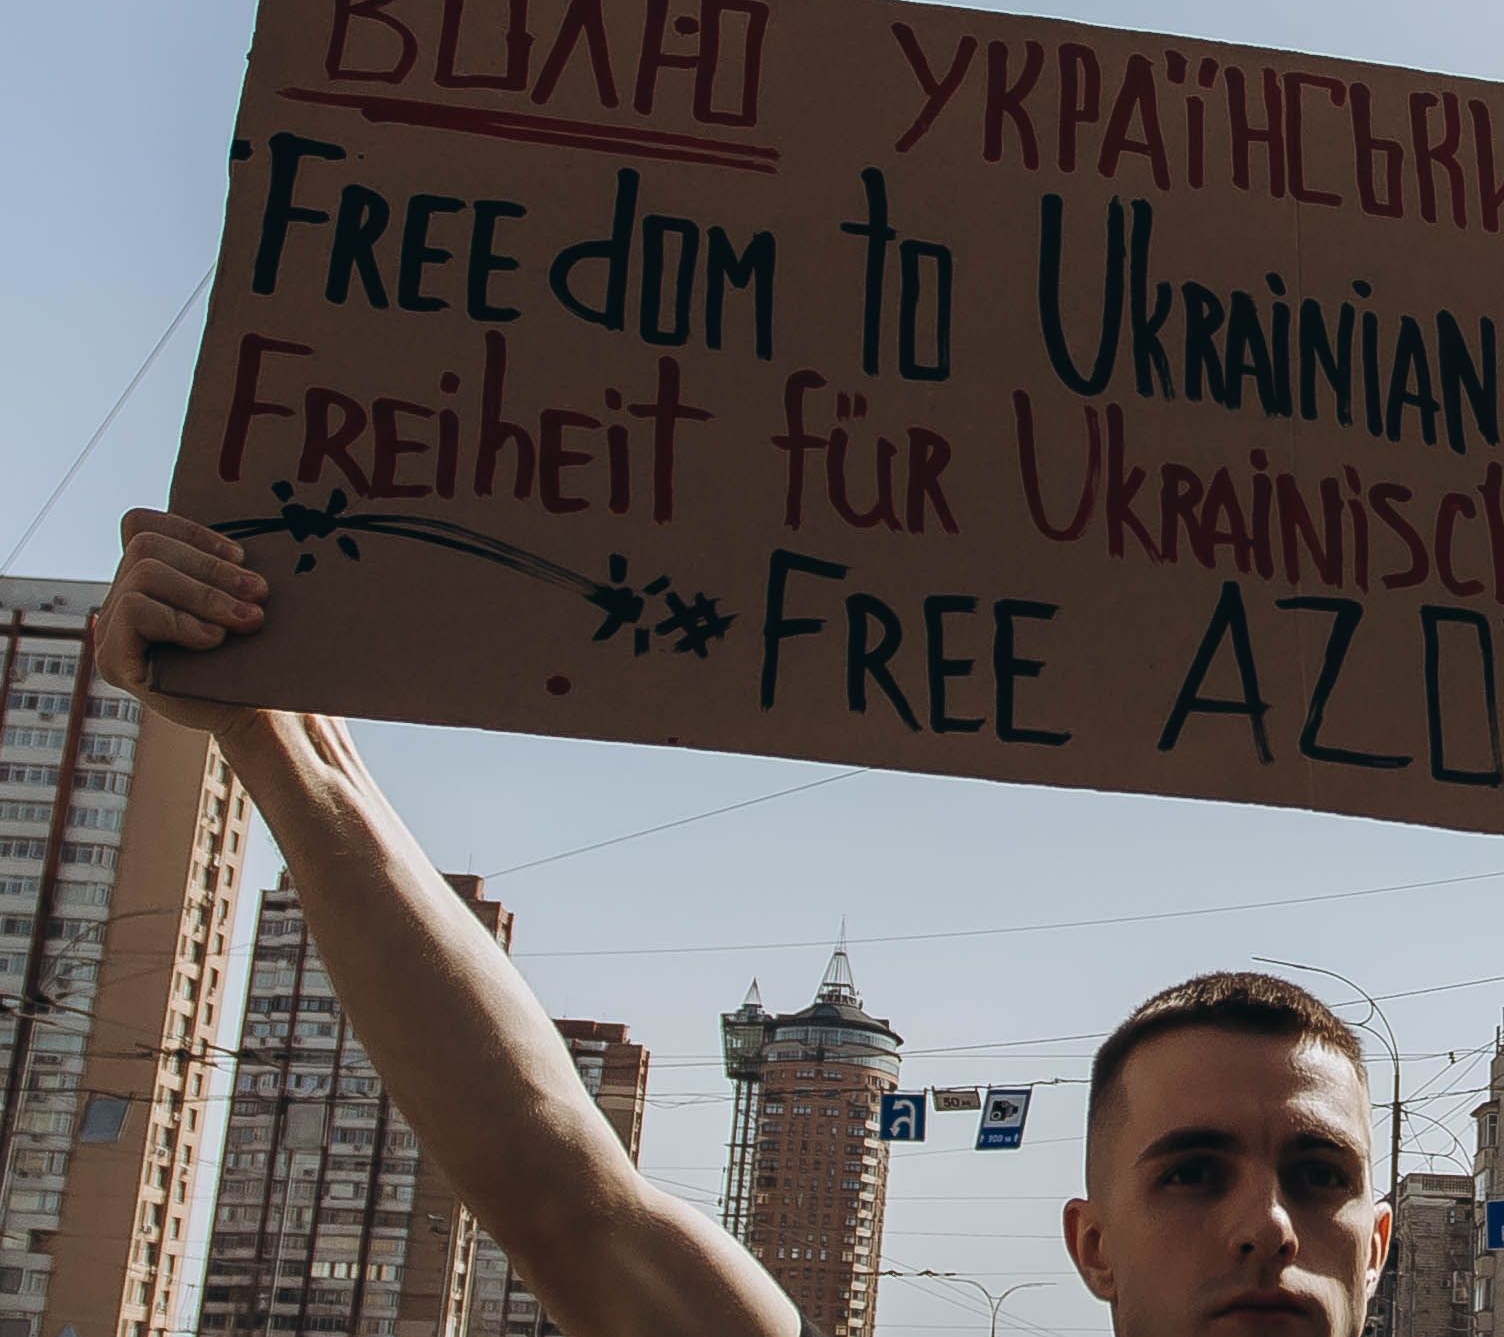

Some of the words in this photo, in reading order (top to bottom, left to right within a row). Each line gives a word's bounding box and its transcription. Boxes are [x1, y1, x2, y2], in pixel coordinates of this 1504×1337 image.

[840, 166, 953, 382] to
[759, 550, 1073, 747] FREE
[943, 1097, 960, 1108] 50
